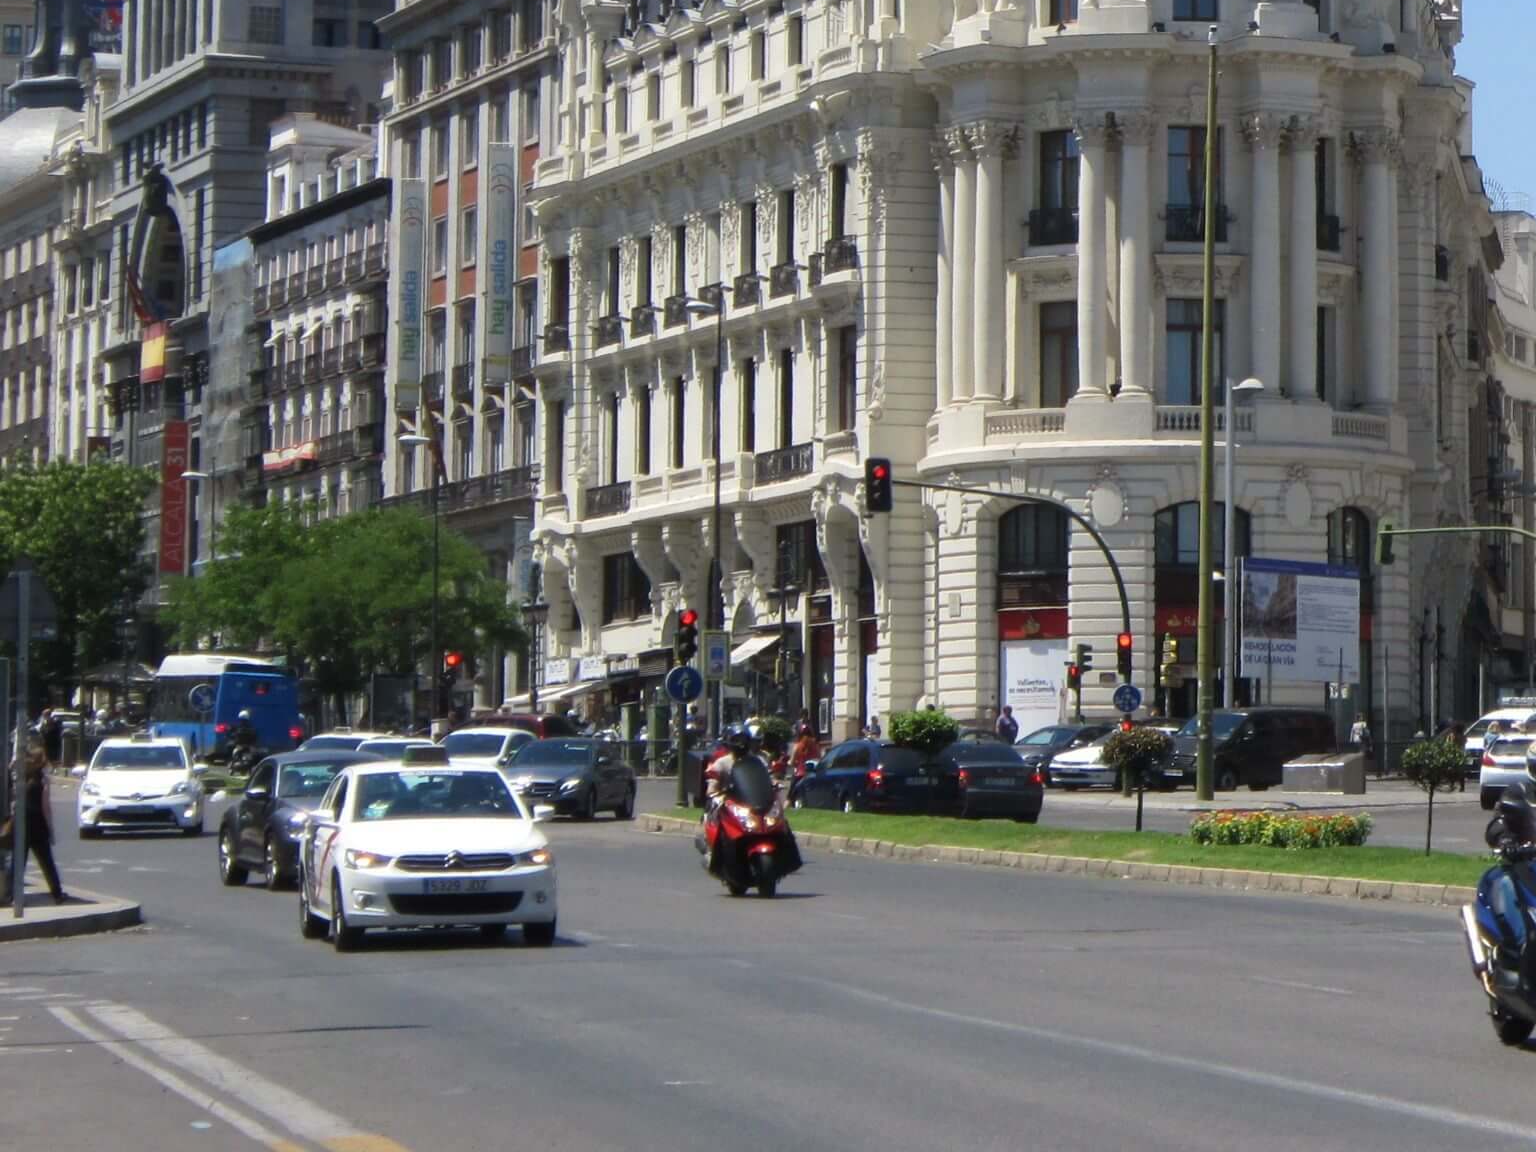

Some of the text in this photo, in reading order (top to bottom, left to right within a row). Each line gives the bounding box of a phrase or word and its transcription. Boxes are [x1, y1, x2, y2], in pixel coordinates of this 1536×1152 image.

[489, 239, 509, 336] hay salida
[400, 270, 420, 361] hay salida
[1244, 641, 1296, 653] REMODLACIÓN
[1263, 655, 1282, 665] GAN
